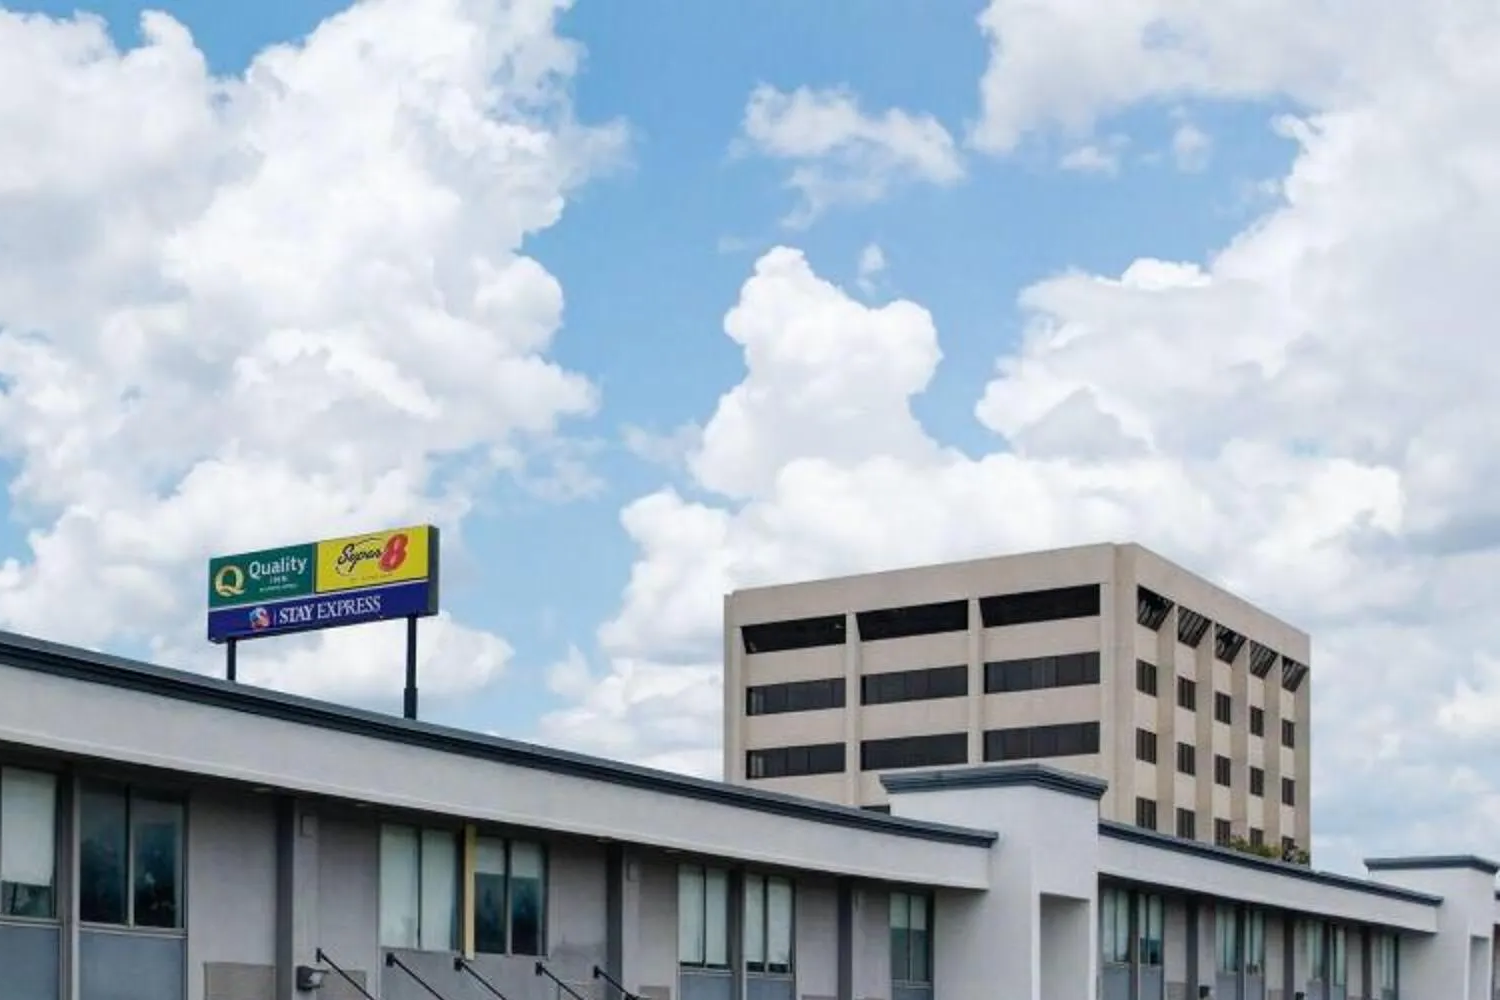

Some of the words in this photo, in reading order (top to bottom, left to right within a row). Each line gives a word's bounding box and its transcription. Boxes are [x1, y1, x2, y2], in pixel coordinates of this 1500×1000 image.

[249, 555, 308, 580] Quality
[379, 533, 409, 573] 8
[214, 565, 246, 597] Q
[279, 604, 313, 625] STAY
[317, 595, 381, 620] EXPRESS
